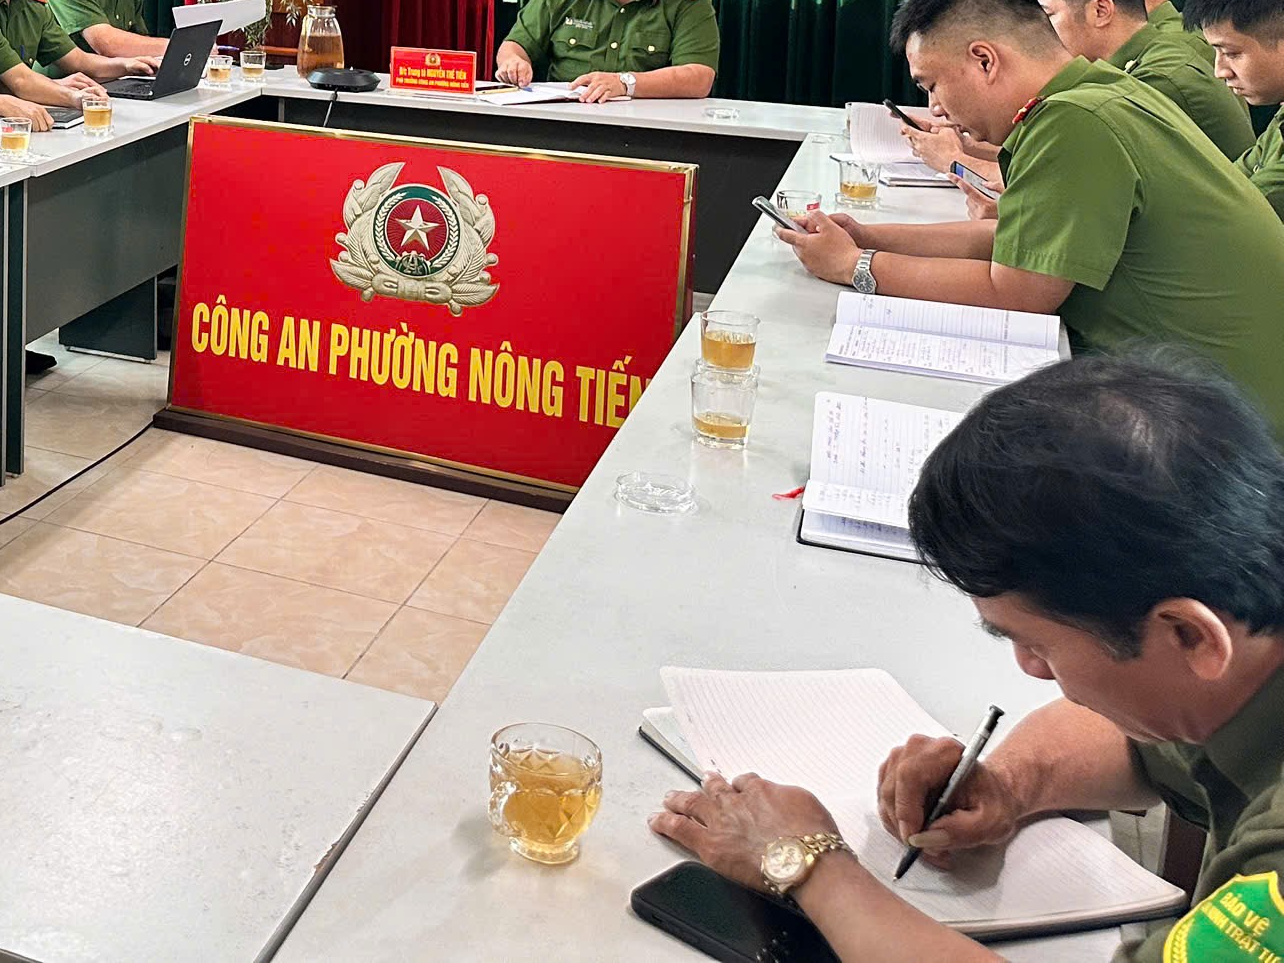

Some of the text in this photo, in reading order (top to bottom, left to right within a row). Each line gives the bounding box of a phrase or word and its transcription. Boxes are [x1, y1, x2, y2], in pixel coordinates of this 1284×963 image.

[192, 295, 269, 363] CÔNG
[277, 316, 321, 372] AN
[329, 322, 458, 399] PHƯỜNG
[469, 340, 564, 417] NÔNG
[1220, 892, 1270, 936] BẢO VỆ
